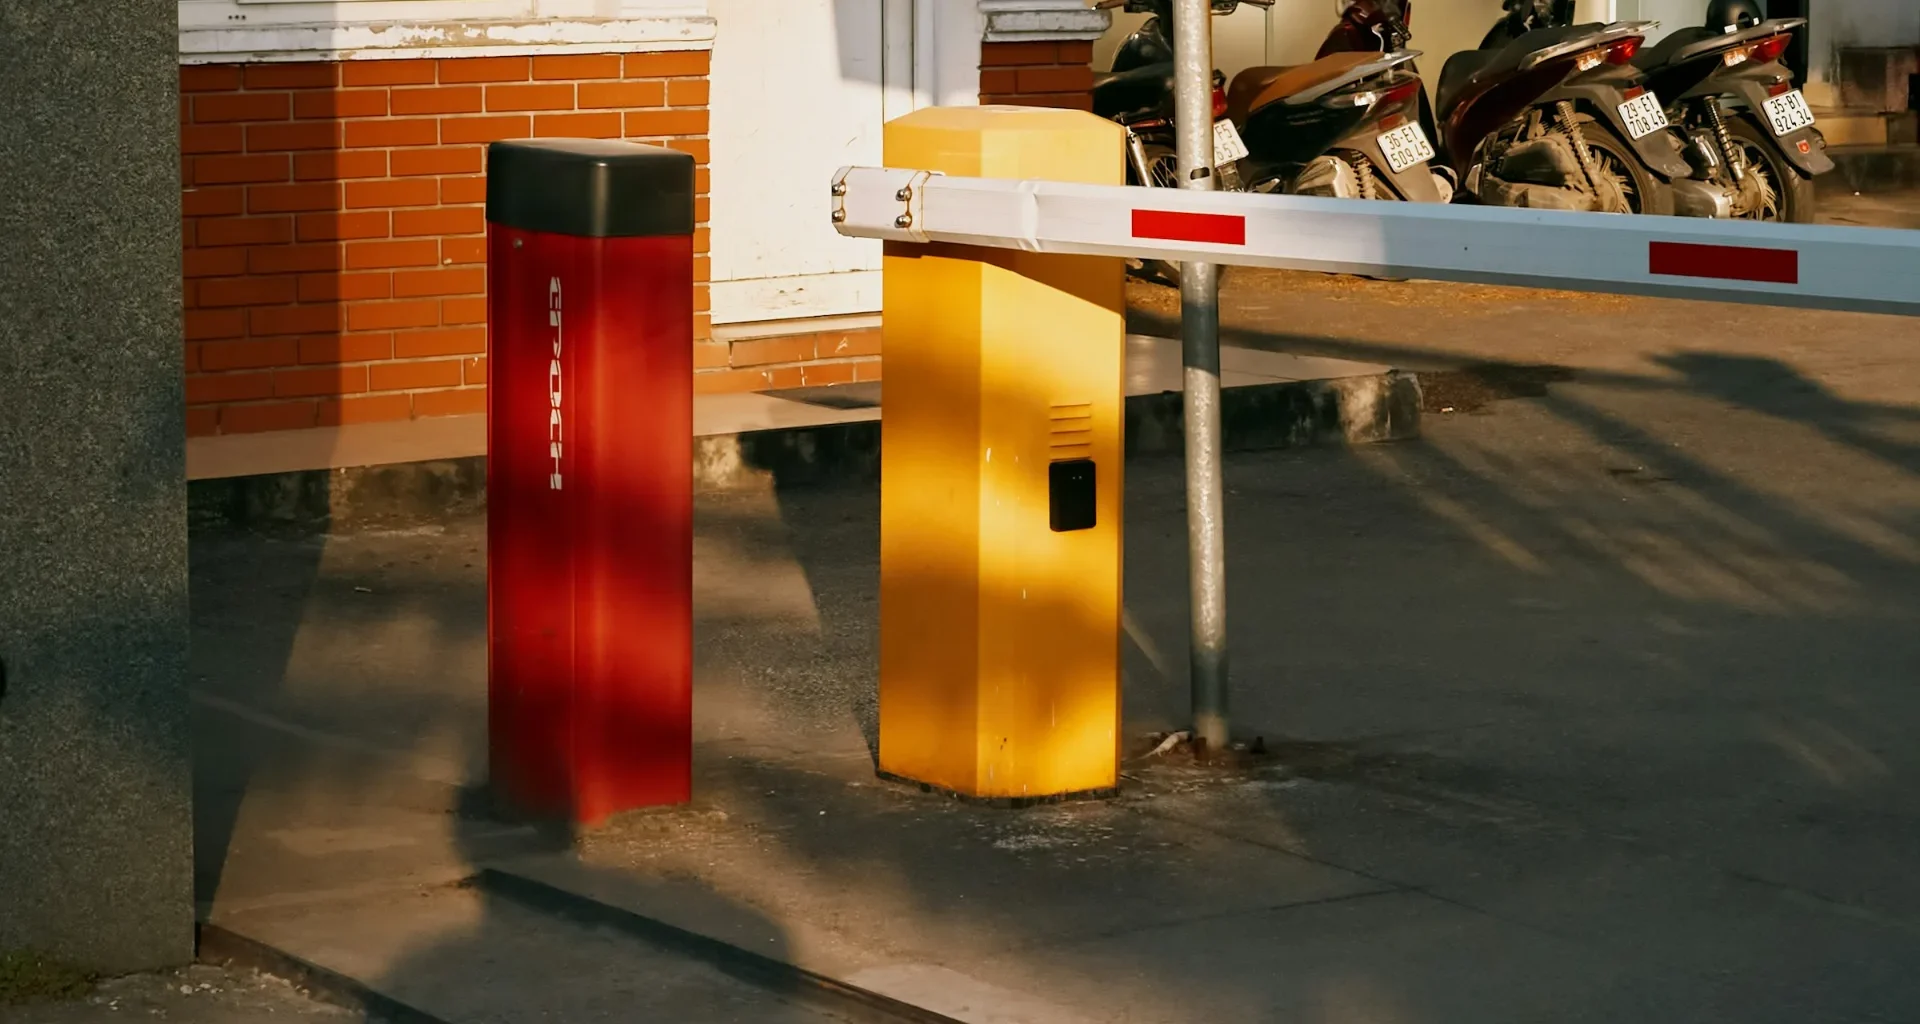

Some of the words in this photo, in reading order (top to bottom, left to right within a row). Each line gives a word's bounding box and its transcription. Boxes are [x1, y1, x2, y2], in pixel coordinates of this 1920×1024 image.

[1623, 95, 1655, 120] 29-E1
[1770, 93, 1801, 115] 35-B1
[1629, 110, 1666, 136] 708.46
[1774, 108, 1812, 132] 924.34
[1384, 125, 1418, 150] 36-E1
[1390, 140, 1431, 168] 509.45
[549, 276, 562, 490] EPOCH
